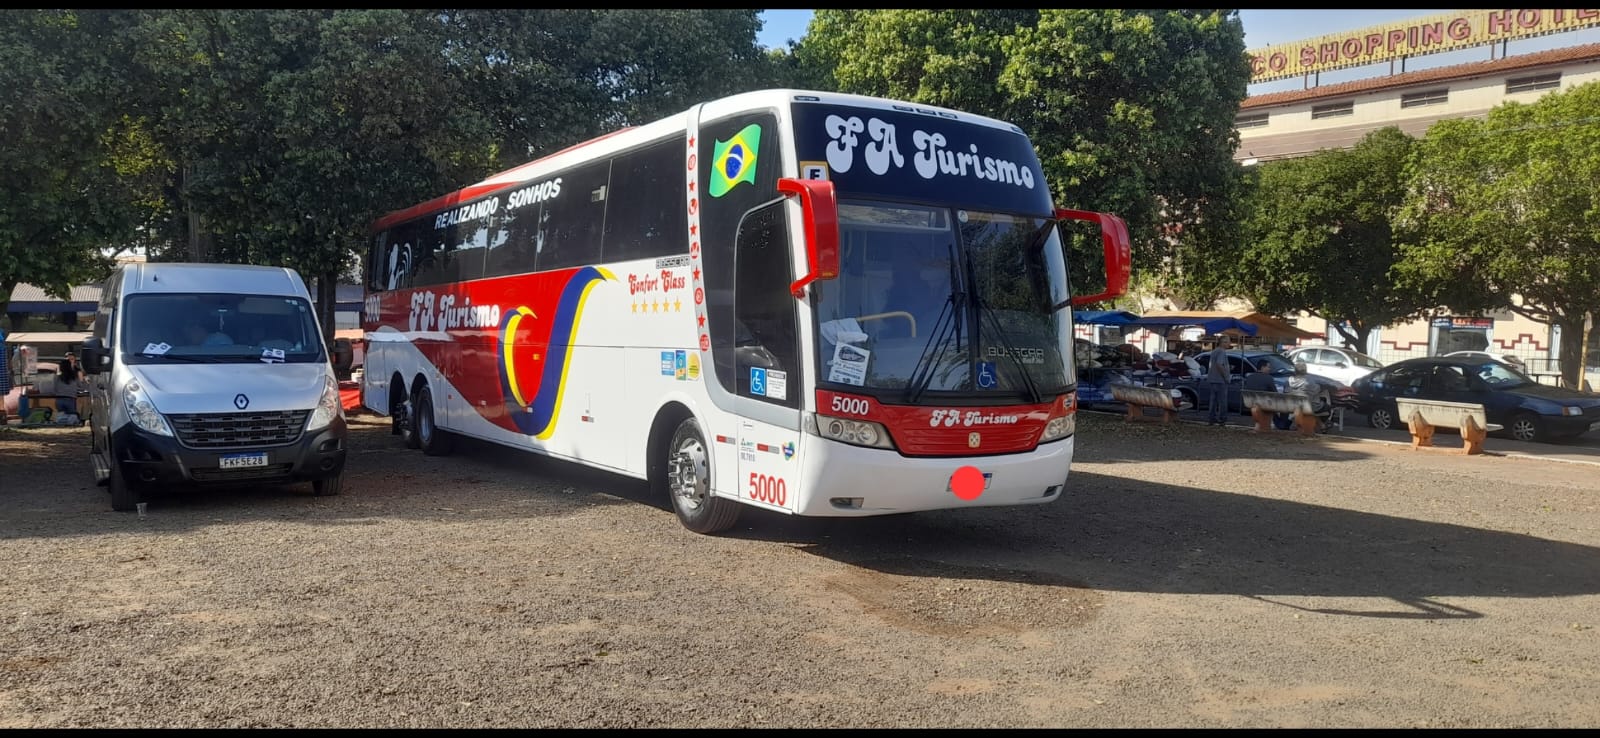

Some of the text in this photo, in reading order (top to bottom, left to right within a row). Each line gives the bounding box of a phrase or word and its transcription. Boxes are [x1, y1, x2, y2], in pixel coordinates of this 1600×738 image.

[1301, 17, 1471, 67] SHOPPING
[913, 129, 1035, 190] Turismo
[434, 177, 563, 230] REALIZANDO SONHOS
[628, 269, 686, 296] Confort Class
[437, 293, 500, 332] Turismo
[831, 395, 870, 416] 5000
[963, 410, 1018, 428] Turismo
[224, 457, 262, 467] FKF5E28
[749, 471, 787, 506] 5000
